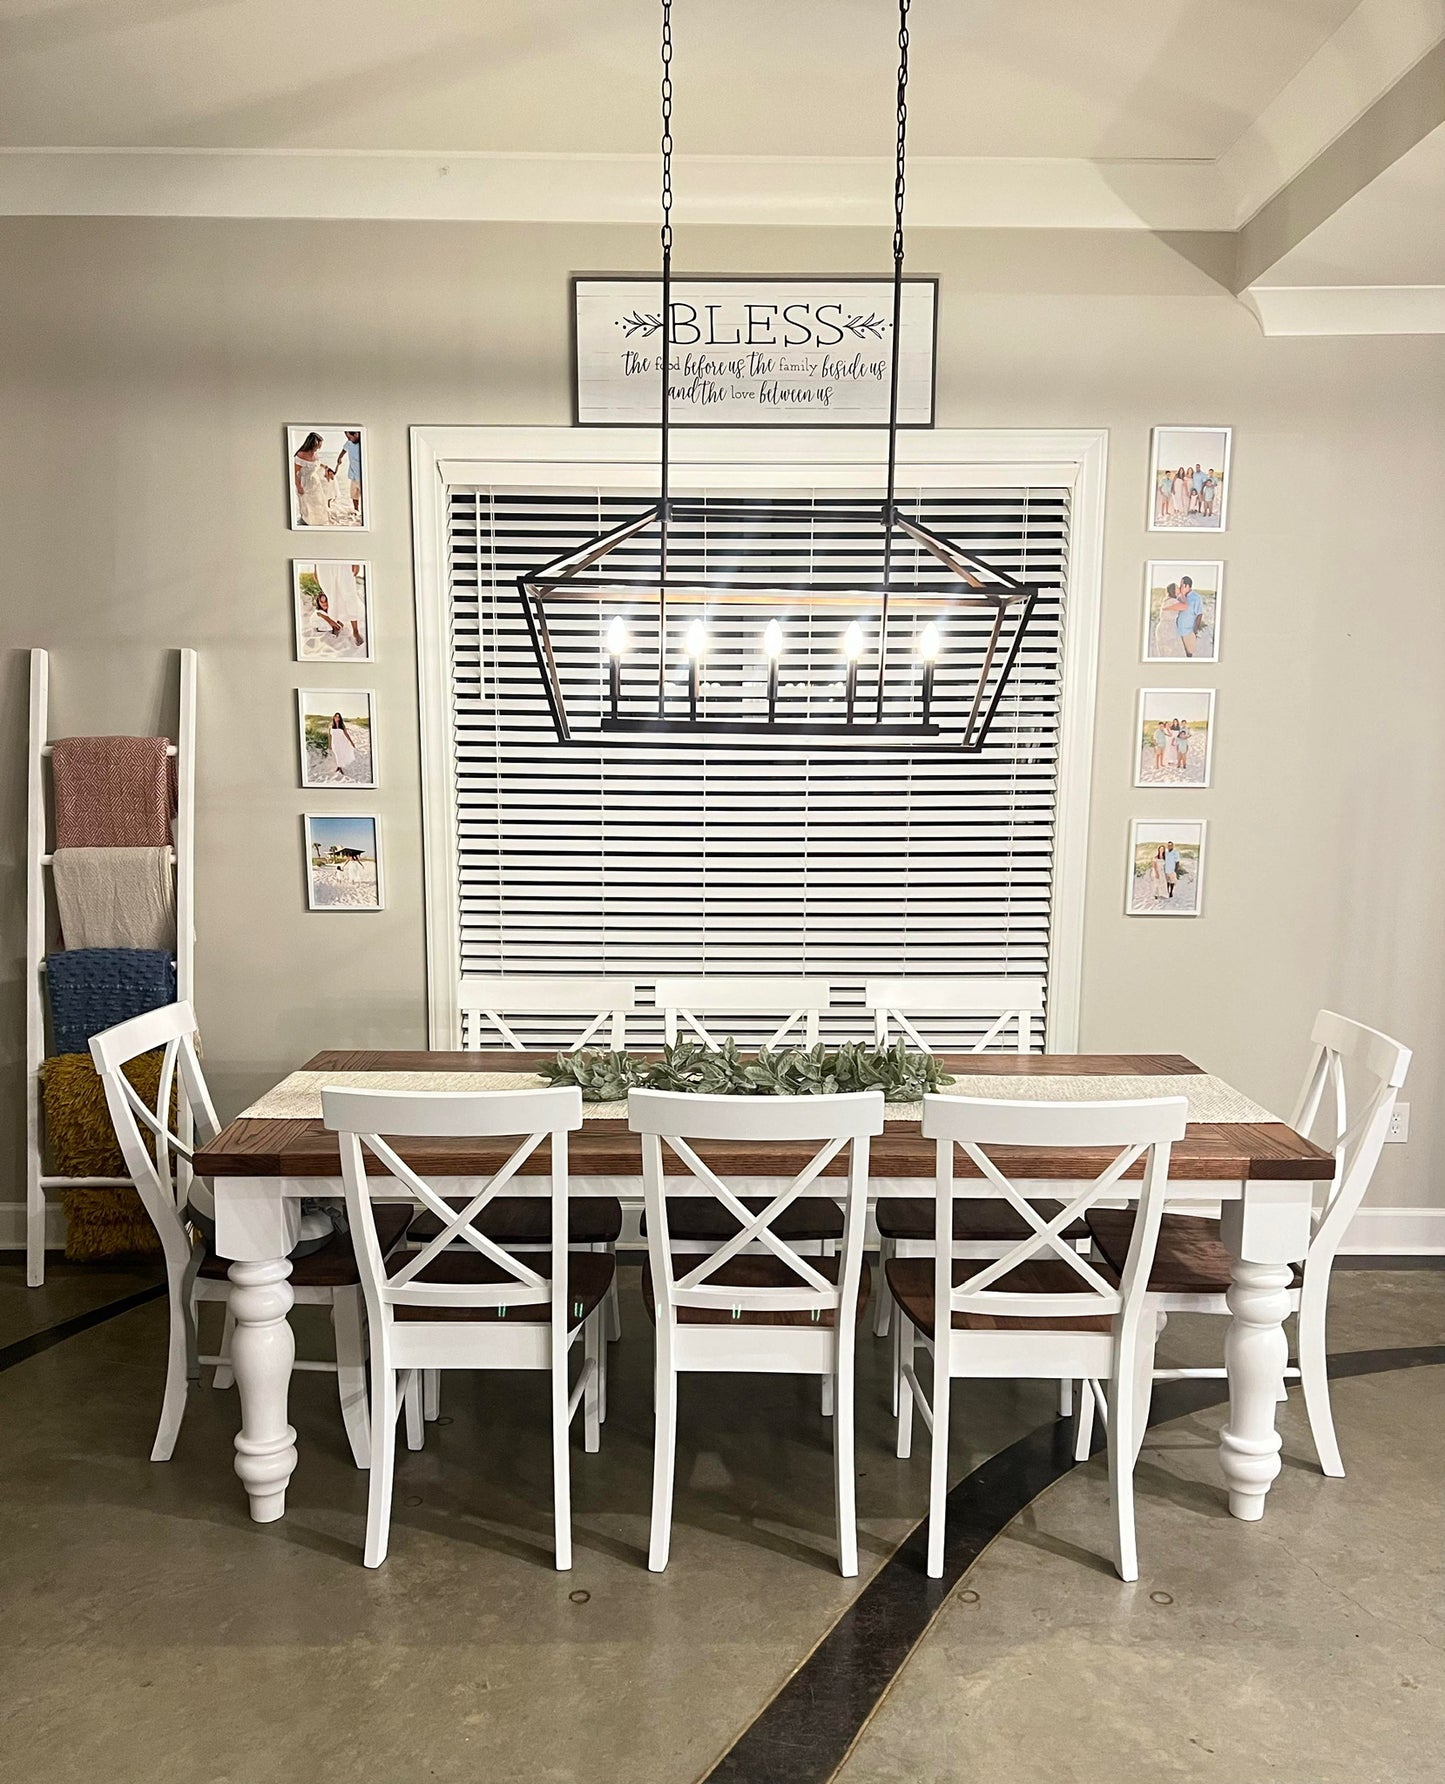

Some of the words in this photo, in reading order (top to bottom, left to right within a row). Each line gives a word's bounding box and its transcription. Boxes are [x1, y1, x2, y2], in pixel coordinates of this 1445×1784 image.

[668, 302, 844, 347] BLESS
[621, 350, 651, 376] the
[684, 352, 727, 379] before
[746, 351, 776, 377] the
[779, 356, 818, 377] family
[821, 352, 869, 380] beside
[869, 359, 887, 381] us
[668, 376, 700, 403] and
[698, 379, 728, 405] the
[731, 385, 756, 399] love
[759, 380, 816, 405] between
